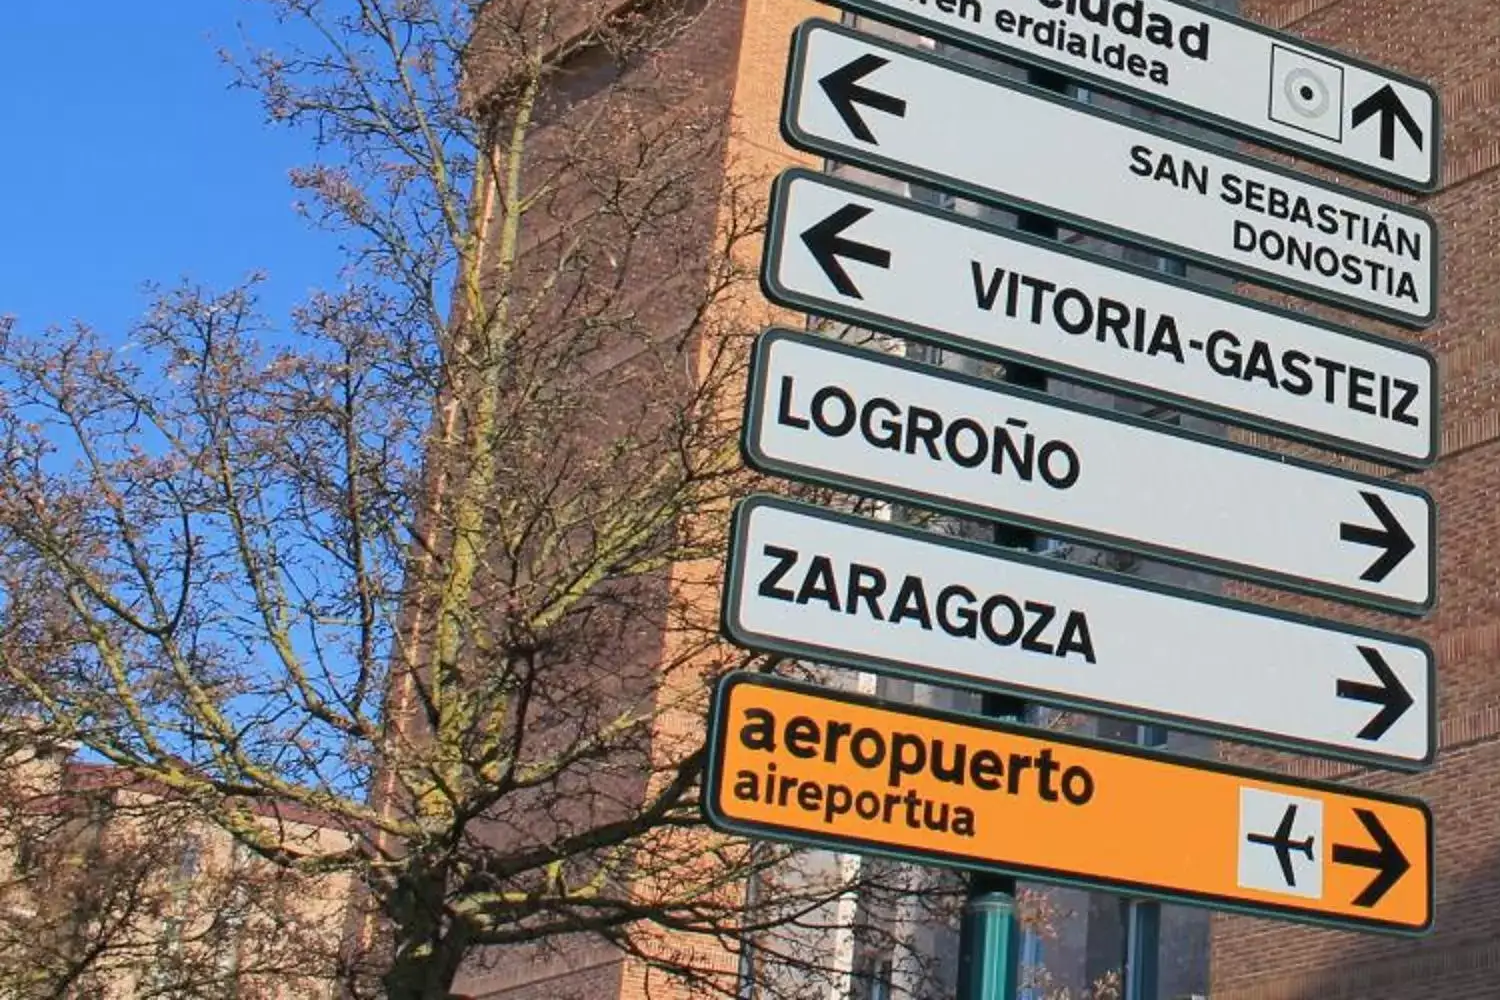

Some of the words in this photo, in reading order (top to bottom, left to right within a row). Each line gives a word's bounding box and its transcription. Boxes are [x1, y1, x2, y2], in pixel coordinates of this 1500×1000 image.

[995, 9, 1169, 86] erdialdea
[1129, 146, 1209, 195] SAN
[1220, 174, 1421, 261] SEBASTIÁN
[1233, 220, 1419, 304] DONOSTIA
[971, 260, 1419, 427] VITORIA-GASTEIZ
[777, 375, 1081, 490] LOGROÑO
[758, 544, 1097, 665] ZARAGOZA
[733, 762, 976, 838] aireportua
[739, 707, 1095, 806] aeropuerto
